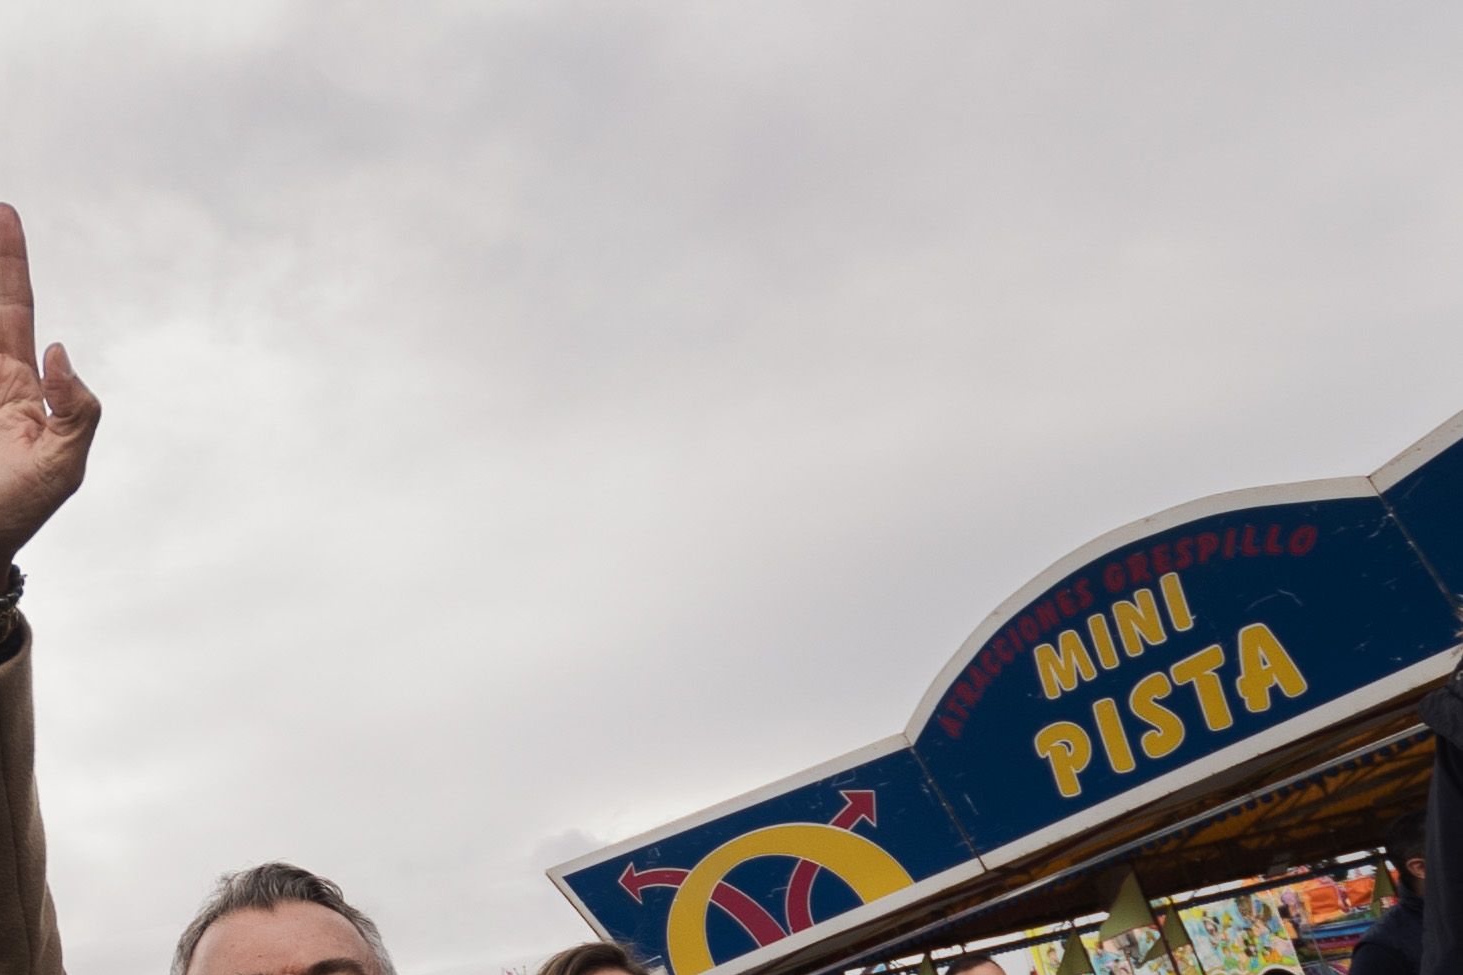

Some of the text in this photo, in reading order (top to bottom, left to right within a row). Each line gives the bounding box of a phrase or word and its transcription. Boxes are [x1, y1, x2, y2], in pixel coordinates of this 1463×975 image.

[937, 577, 1094, 739] ATRACCIONES
[1034, 572, 1194, 700] MINI
[1035, 622, 1309, 798] PISTA
